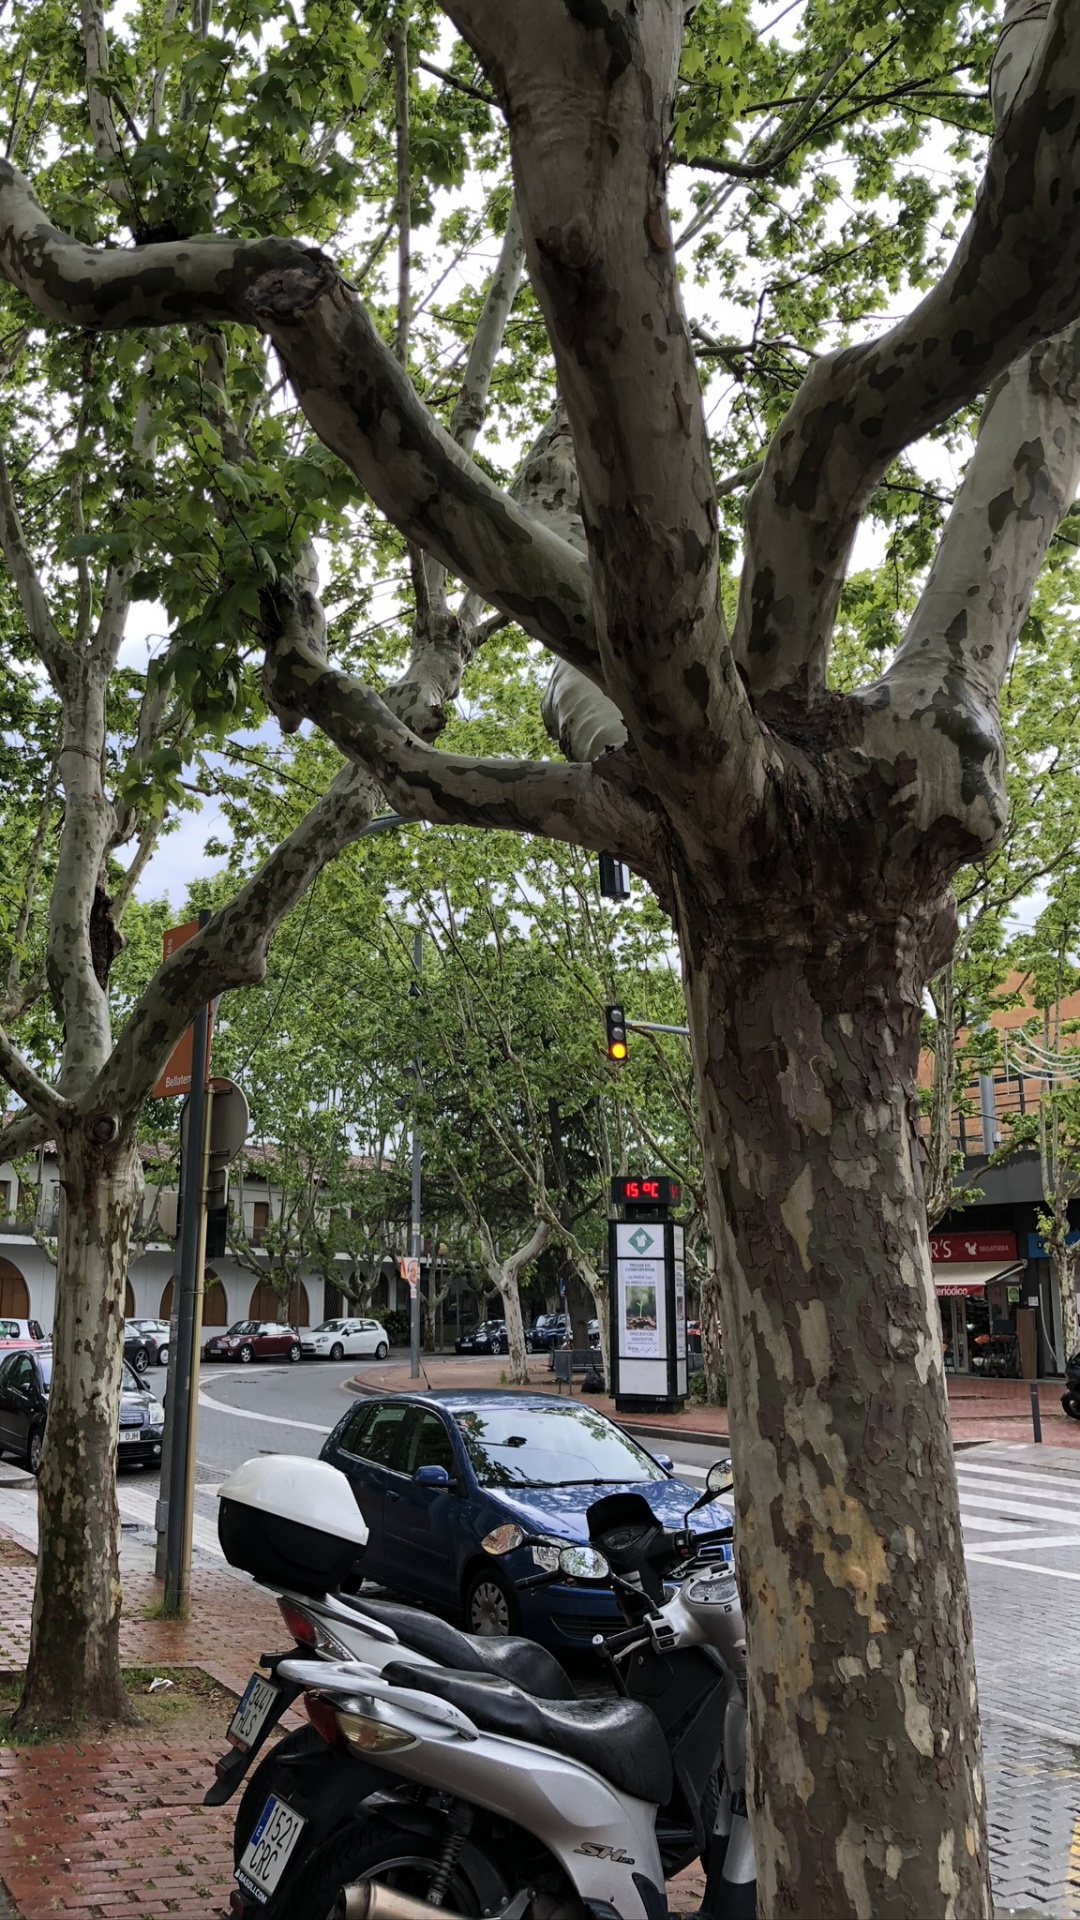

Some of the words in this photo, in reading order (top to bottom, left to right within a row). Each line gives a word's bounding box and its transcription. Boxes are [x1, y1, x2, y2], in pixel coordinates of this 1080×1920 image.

[626, 1182, 639, 1198] 15
[249, 1683, 274, 1715] 3441
[235, 1708, 257, 1737] HLS
[266, 1806, 298, 1854] 1521
[249, 1838, 278, 1881] CRC
